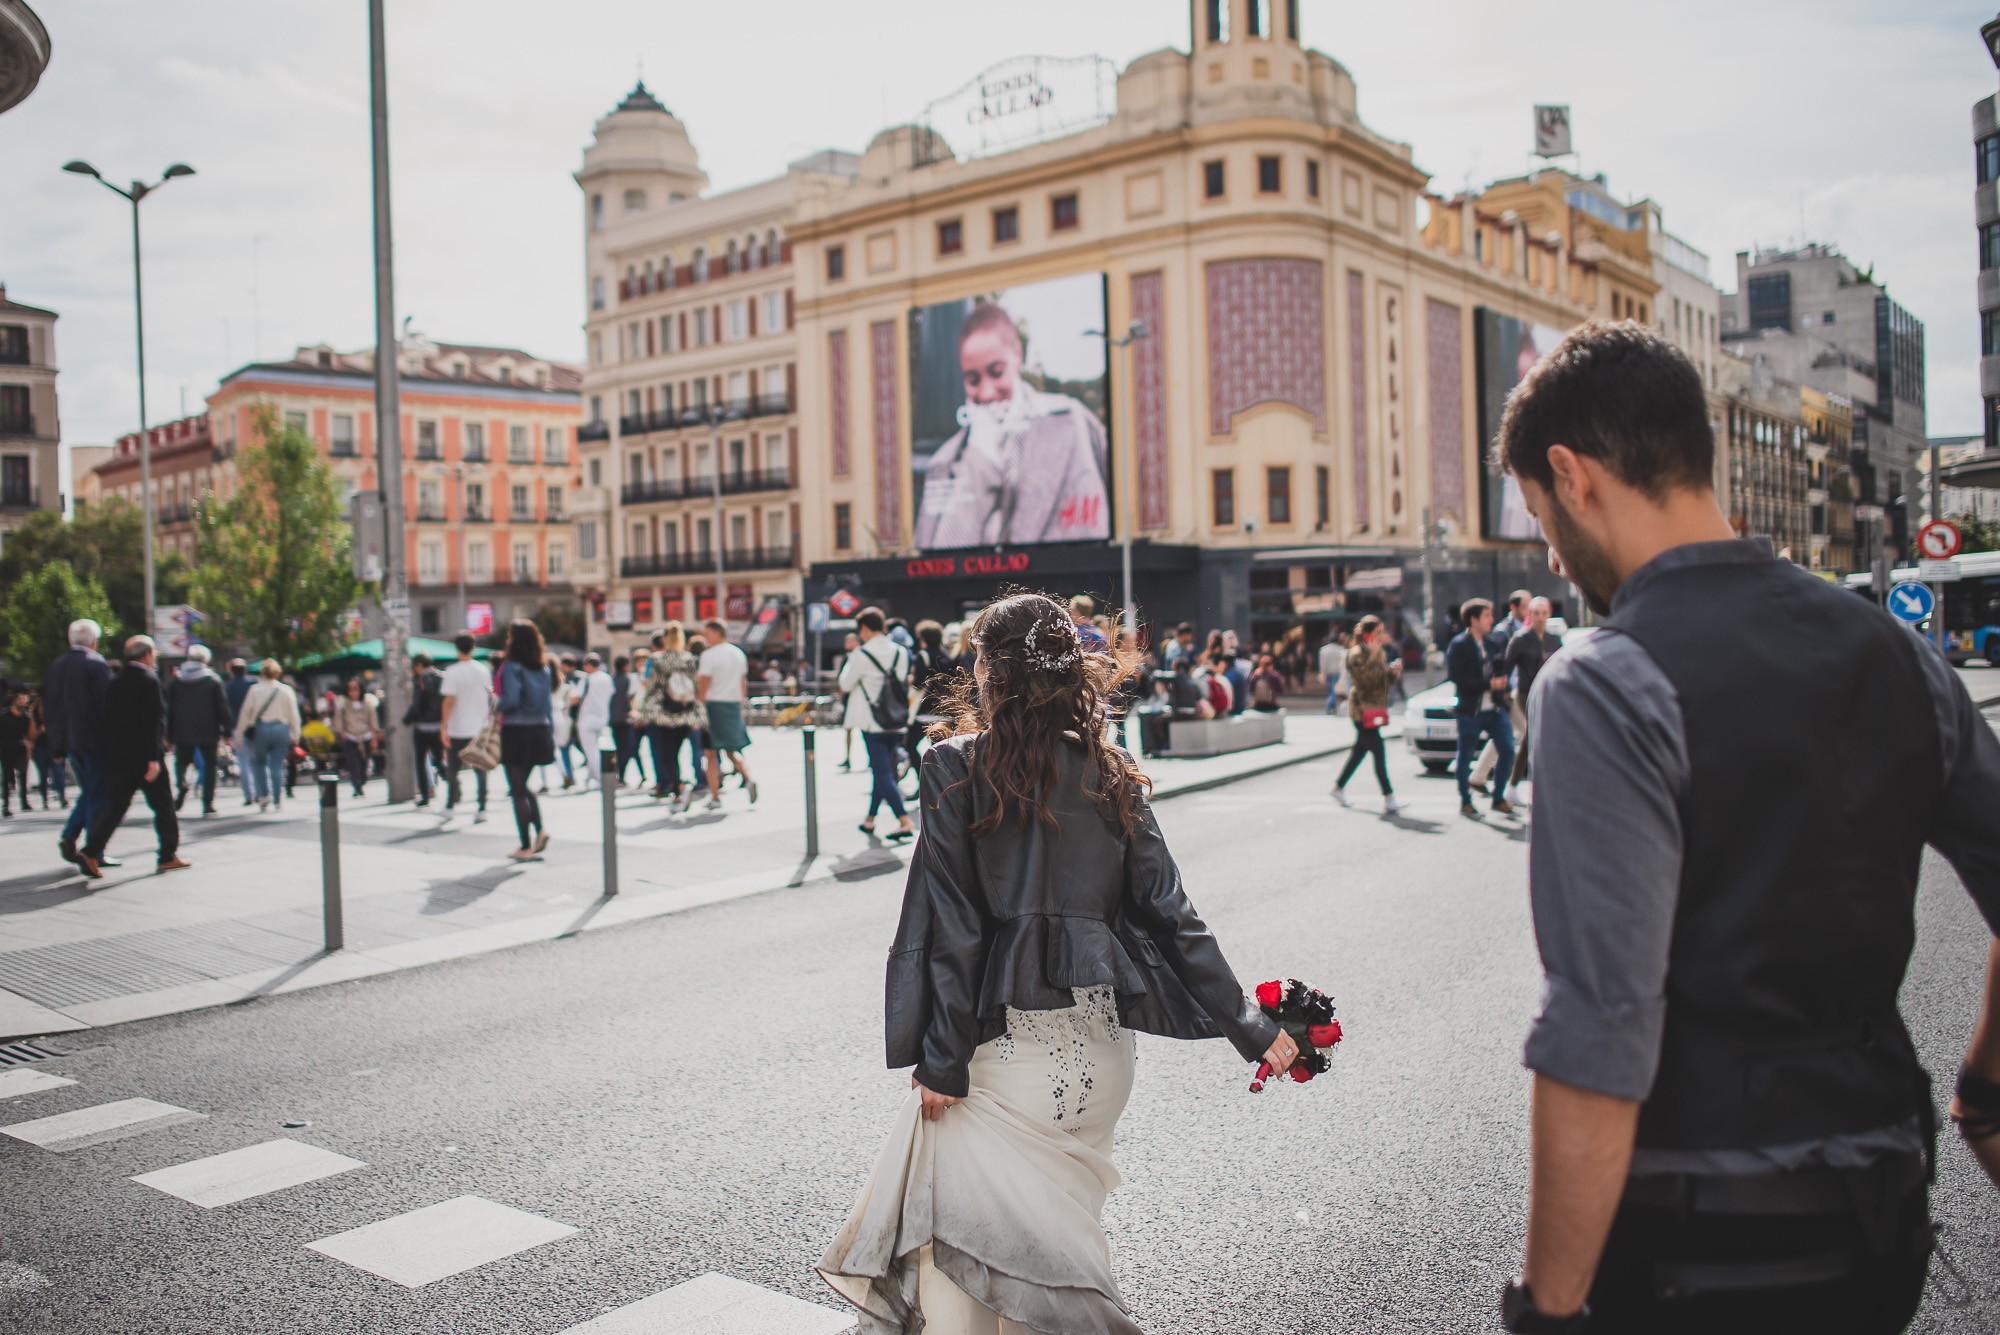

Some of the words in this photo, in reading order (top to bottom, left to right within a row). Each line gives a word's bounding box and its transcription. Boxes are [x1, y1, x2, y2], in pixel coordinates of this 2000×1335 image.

[1386, 295, 1402, 517] CALLAO
[907, 557, 956, 577] CINES
[963, 552, 1029, 574] CALLAO
